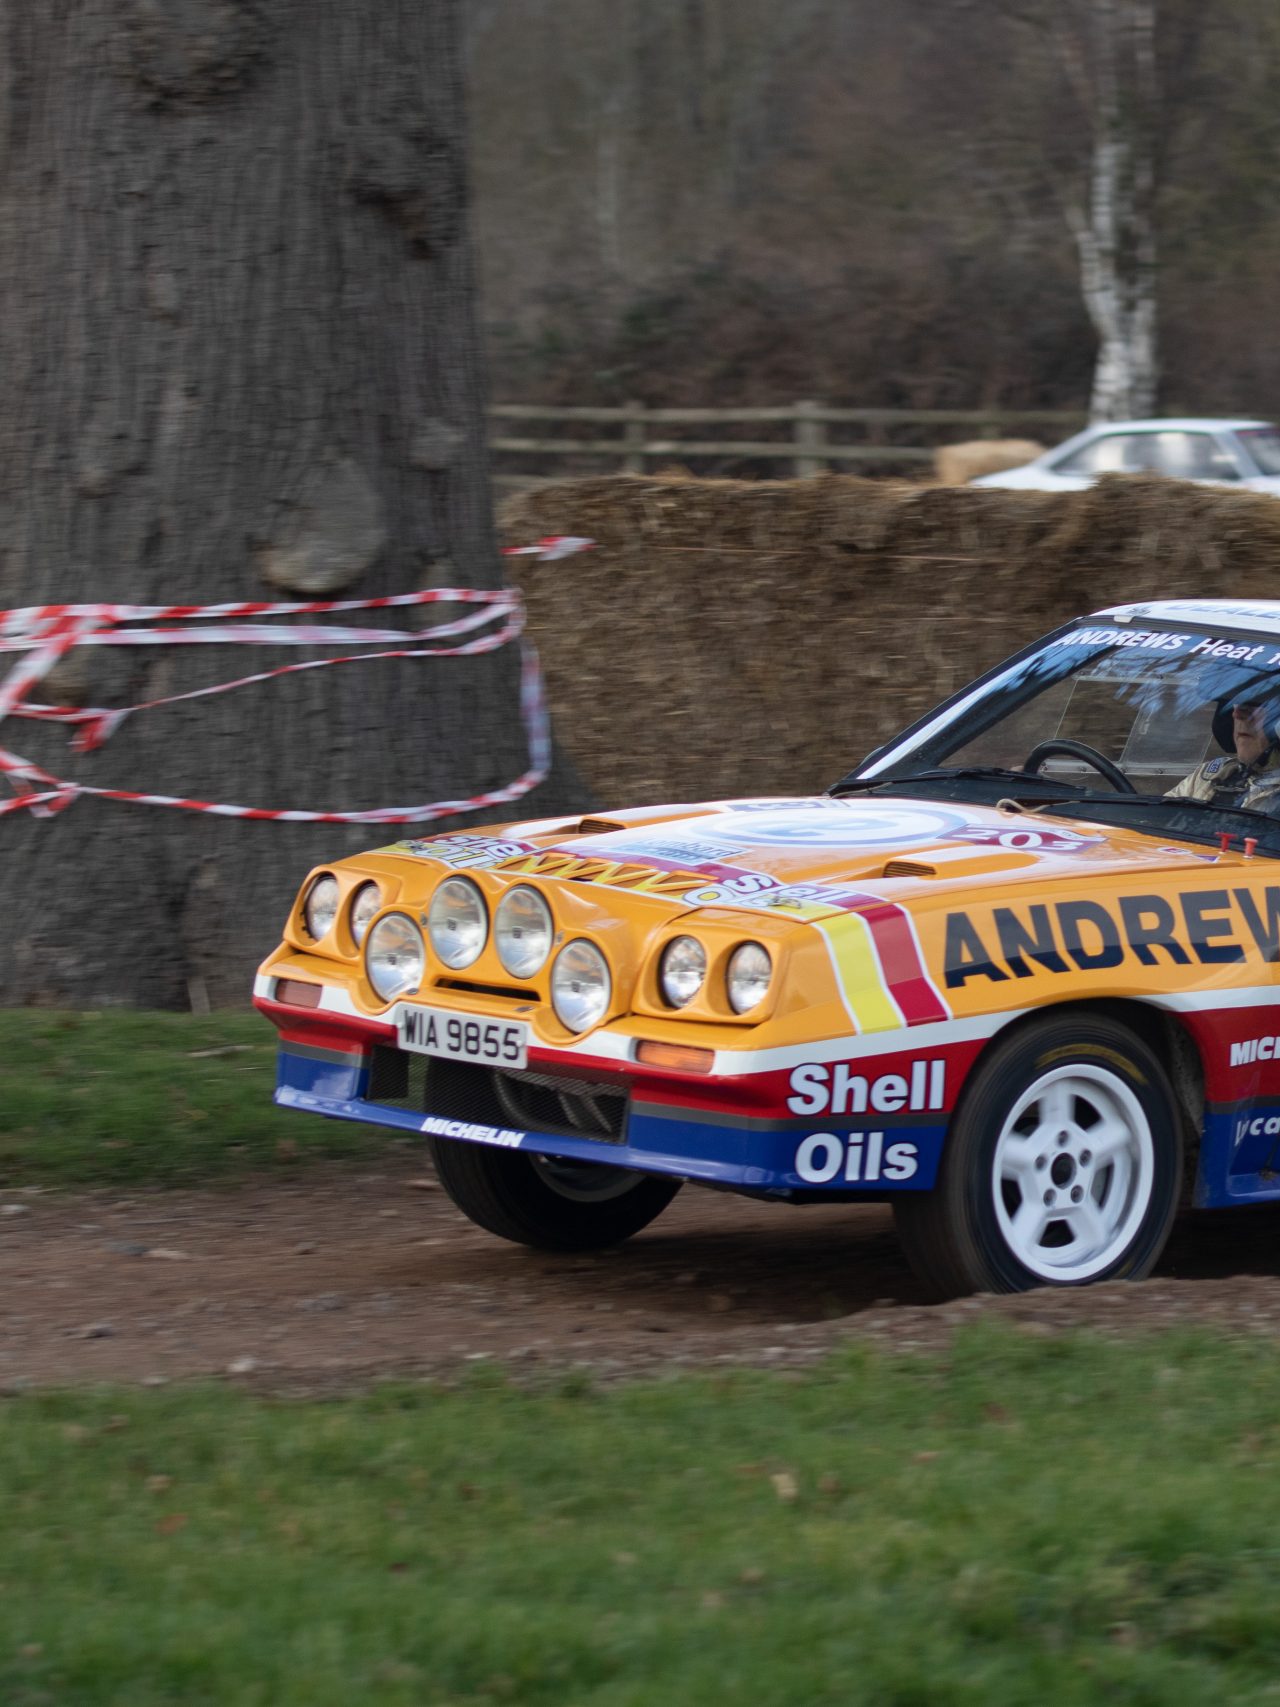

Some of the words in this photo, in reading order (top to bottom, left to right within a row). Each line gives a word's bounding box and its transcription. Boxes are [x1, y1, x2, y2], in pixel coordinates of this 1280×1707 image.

[1051, 630, 1192, 650] ANDREWS
[1189, 638, 1264, 661] Heat
[404, 1010, 438, 1049] WIA
[447, 1019, 519, 1061] 9855
[786, 1059, 946, 1116] Shell
[420, 1117, 526, 1148] MICHELIN
[795, 1132, 918, 1183] Oils
